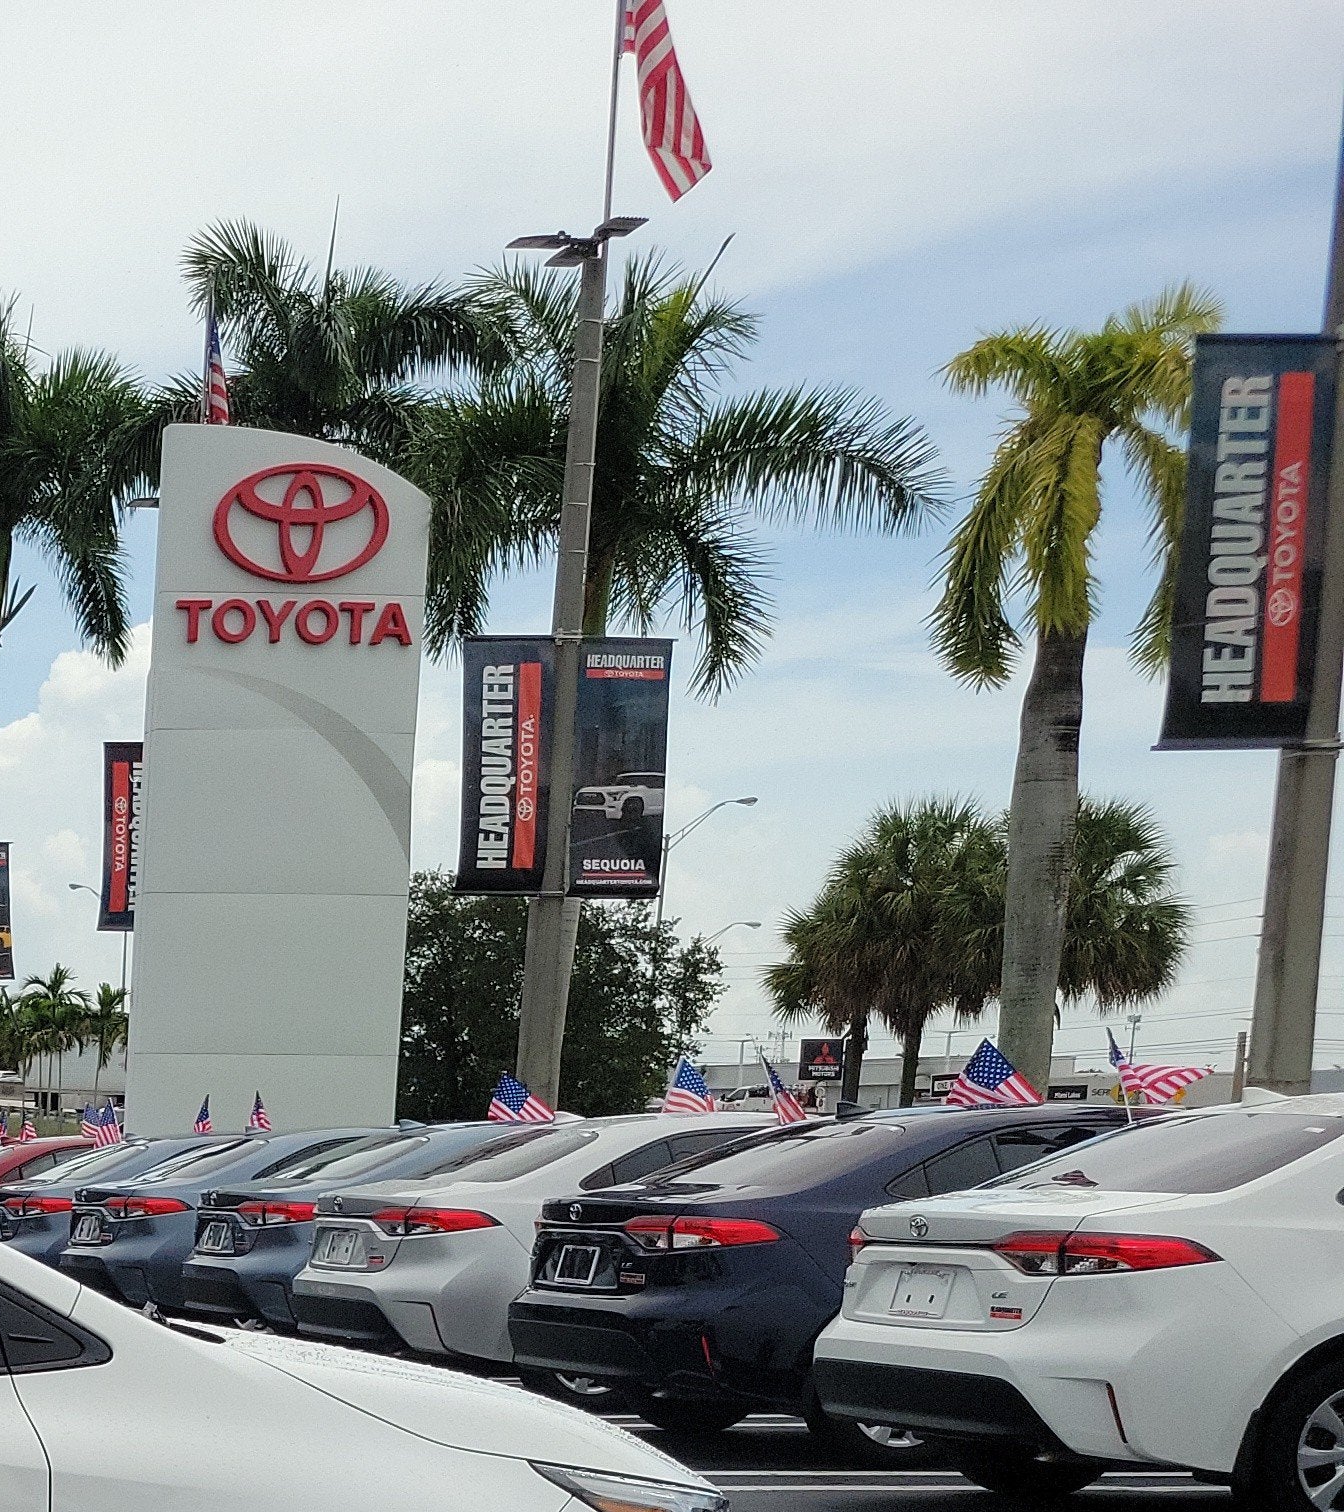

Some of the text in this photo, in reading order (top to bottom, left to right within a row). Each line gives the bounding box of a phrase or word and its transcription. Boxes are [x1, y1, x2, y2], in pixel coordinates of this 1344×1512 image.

[1201, 374, 1273, 703] HEADQUARTER
[1273, 462, 1302, 584] TOYOTA
[176, 599, 412, 646] TOYOTA
[587, 654, 664, 670] HEADQUARTER
[476, 665, 515, 869] HEADQUARTER
[114, 815, 127, 872] TOYOTA
[582, 859, 646, 871] SEQUOIA
